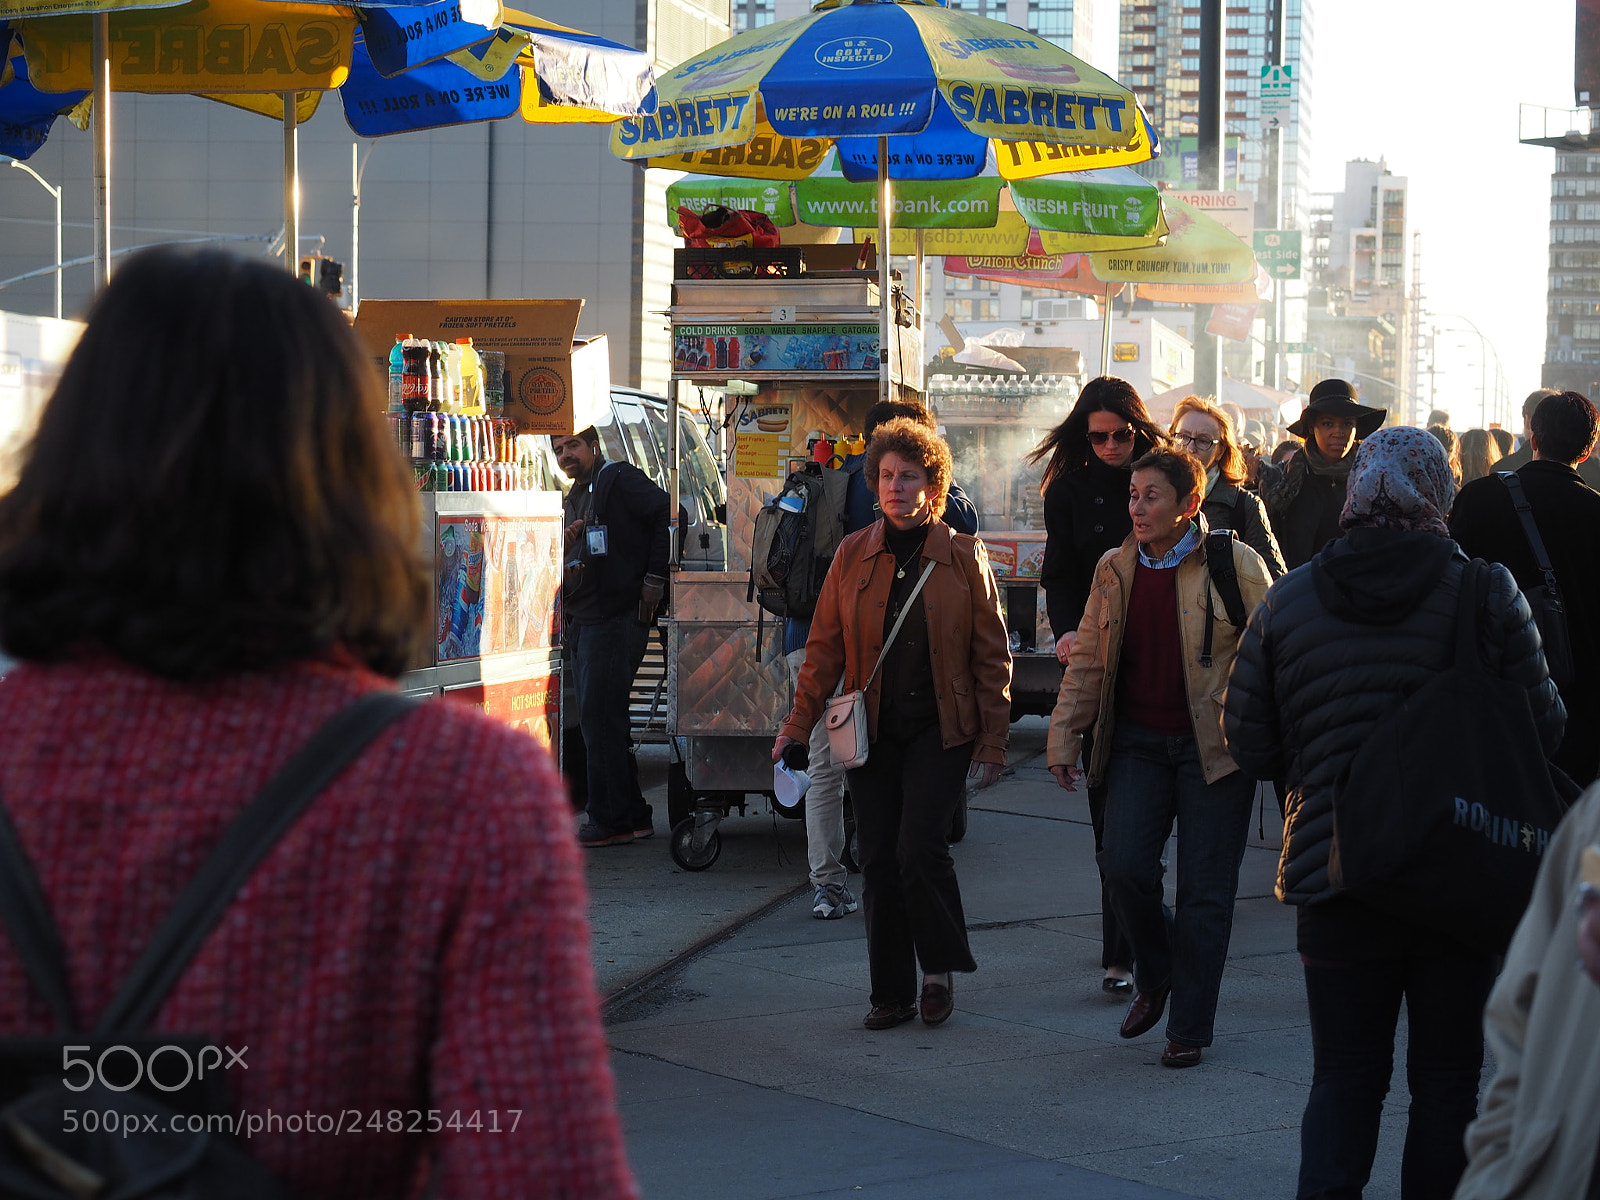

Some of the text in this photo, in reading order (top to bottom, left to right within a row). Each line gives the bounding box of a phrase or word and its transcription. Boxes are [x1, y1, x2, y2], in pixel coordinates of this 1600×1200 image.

[835, 47, 874, 57] GOV'T
[938, 38, 1040, 60] SABRETT
[822, 54, 883, 63] INSPECTED
[774, 103, 916, 121] WE'RE ON A ROLL !!!
[948, 80, 1128, 133] SABRETT
[619, 90, 751, 146] SABRETT
[679, 197, 717, 212] FRESH
[721, 197, 757, 212] FRUIT
[807, 196, 989, 214] www.tbank.com
[1018, 196, 1068, 215] FRESH
[1073, 200, 1119, 219] FRUIT
[1173, 195, 1237, 207] ARNING
[1255, 250, 1299, 259] est Side
[1108, 259, 1134, 272] CRISPY,
[1137, 260, 1170, 273] CRUNCHY,
[779, 309, 787, 321] 3
[680, 326, 703, 335] COLD
[705, 326, 737, 335] DRINKS
[744, 327, 765, 335] SODA
[770, 327, 796, 335] WATER
[802, 327, 836, 335] SNAPPLE
[740, 407, 789, 426] SABRETT
[464, 519, 478, 532] Soda
[511, 689, 552, 711] HOT SAUSAGE
[1453, 796, 1518, 848] ROBIN
